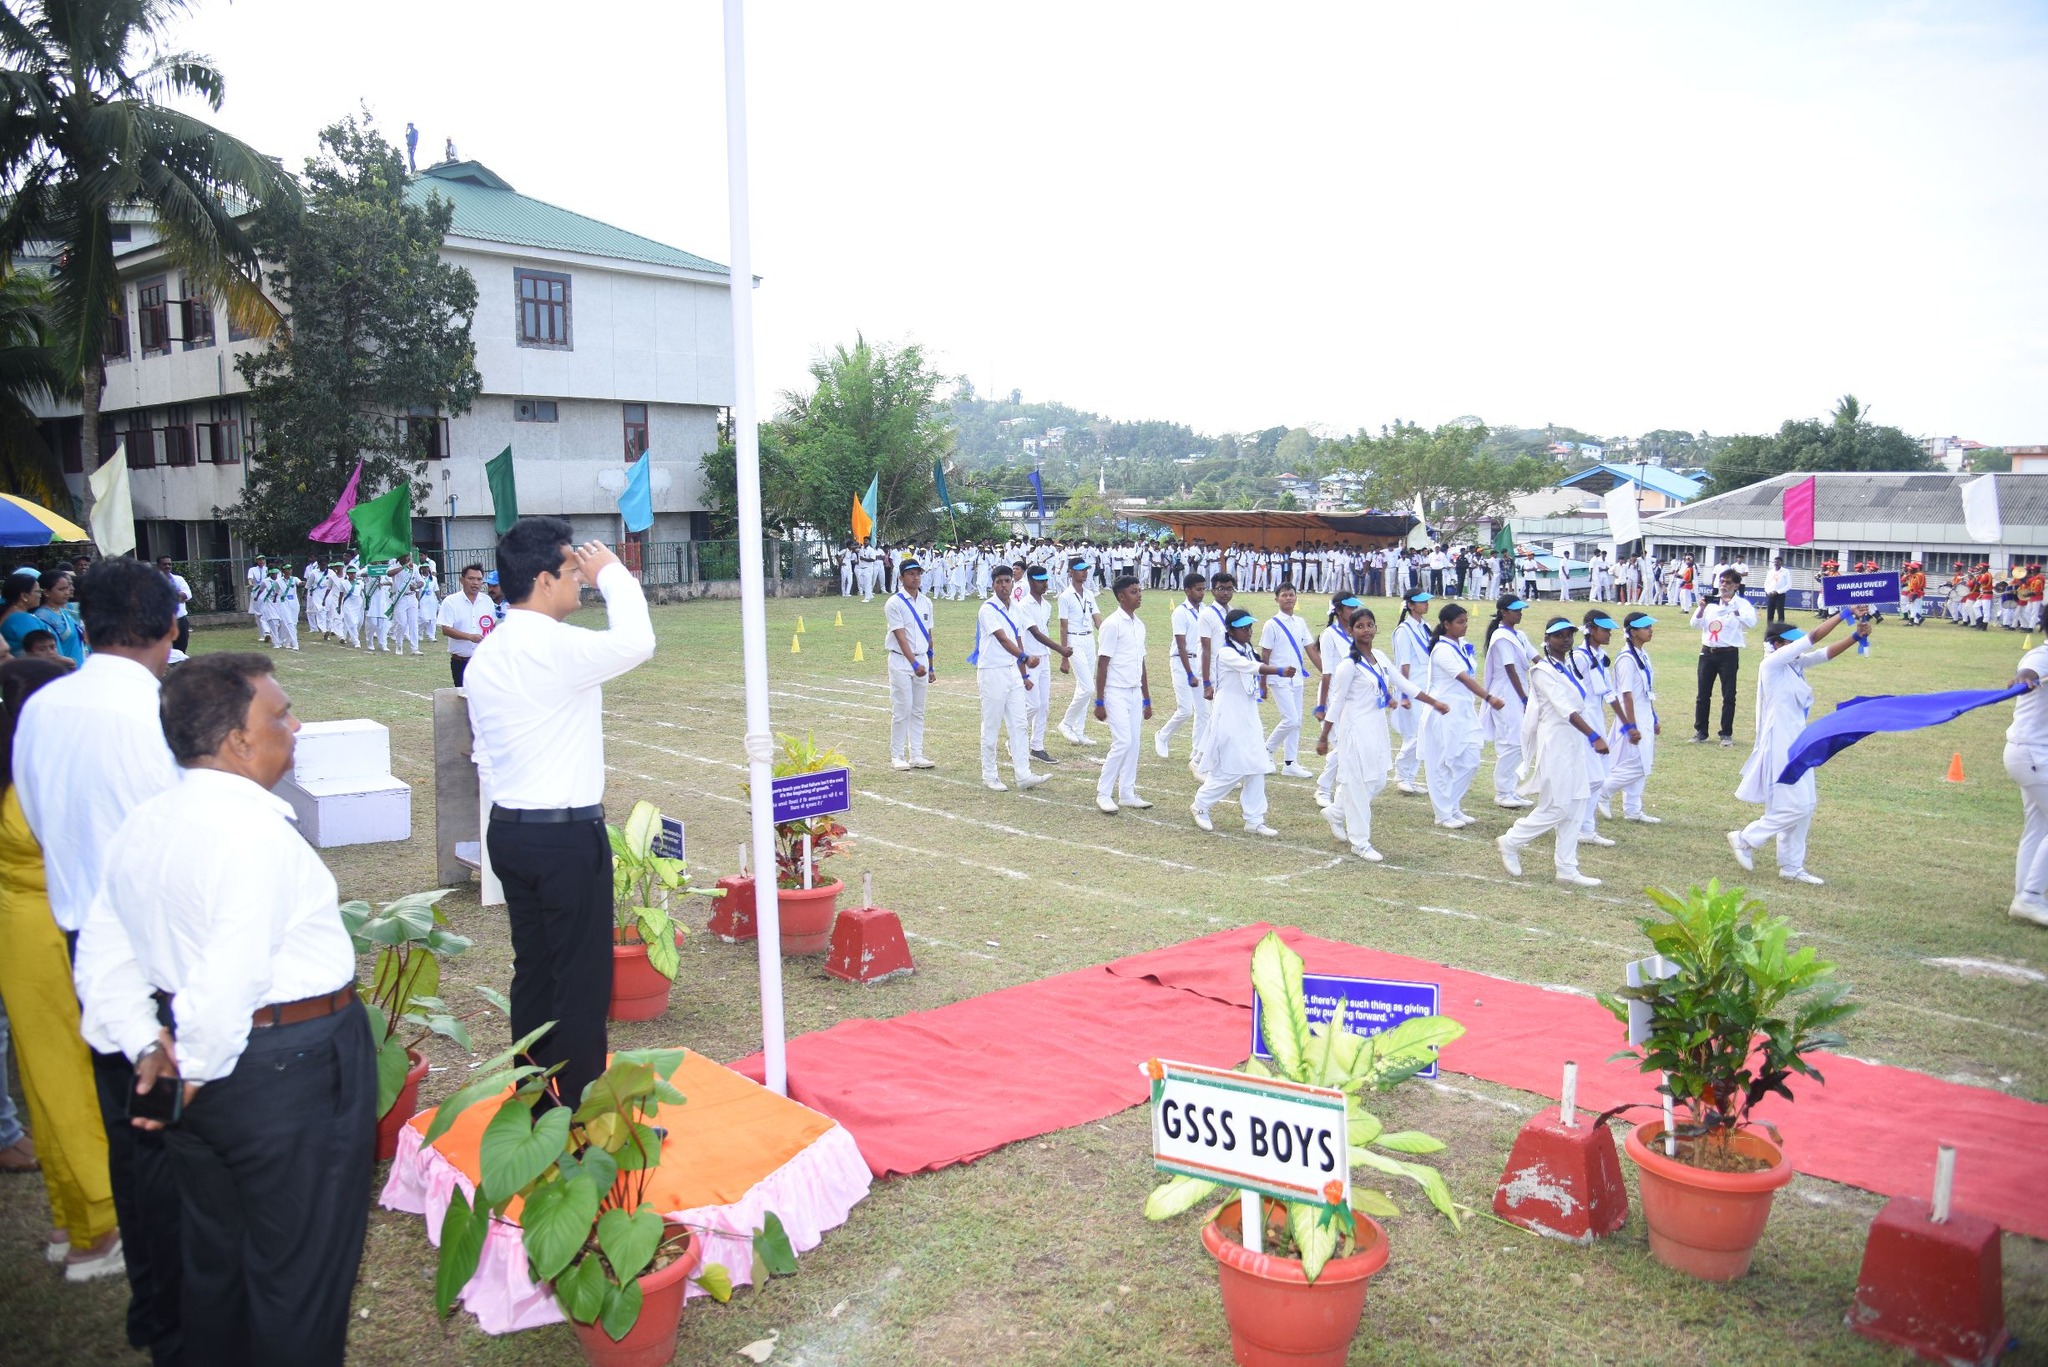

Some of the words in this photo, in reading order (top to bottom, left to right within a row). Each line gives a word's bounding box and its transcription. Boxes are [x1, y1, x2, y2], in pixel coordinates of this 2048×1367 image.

[1836, 582, 1862, 590] SWARAJ
[1863, 580, 1887, 588] DWEEP
[1310, 994, 1336, 1007] there's
[1349, 998, 1369, 1009] such
[1370, 1000, 1391, 1013] thing
[1392, 1003, 1403, 1012] as
[1404, 1003, 1430, 1016] giving
[1305, 1007, 1321, 1019] only
[1355, 1009, 1388, 1022] forward.
[1162, 1099, 1236, 1151] GSSS
[1249, 1115, 1335, 1173] BOYS
